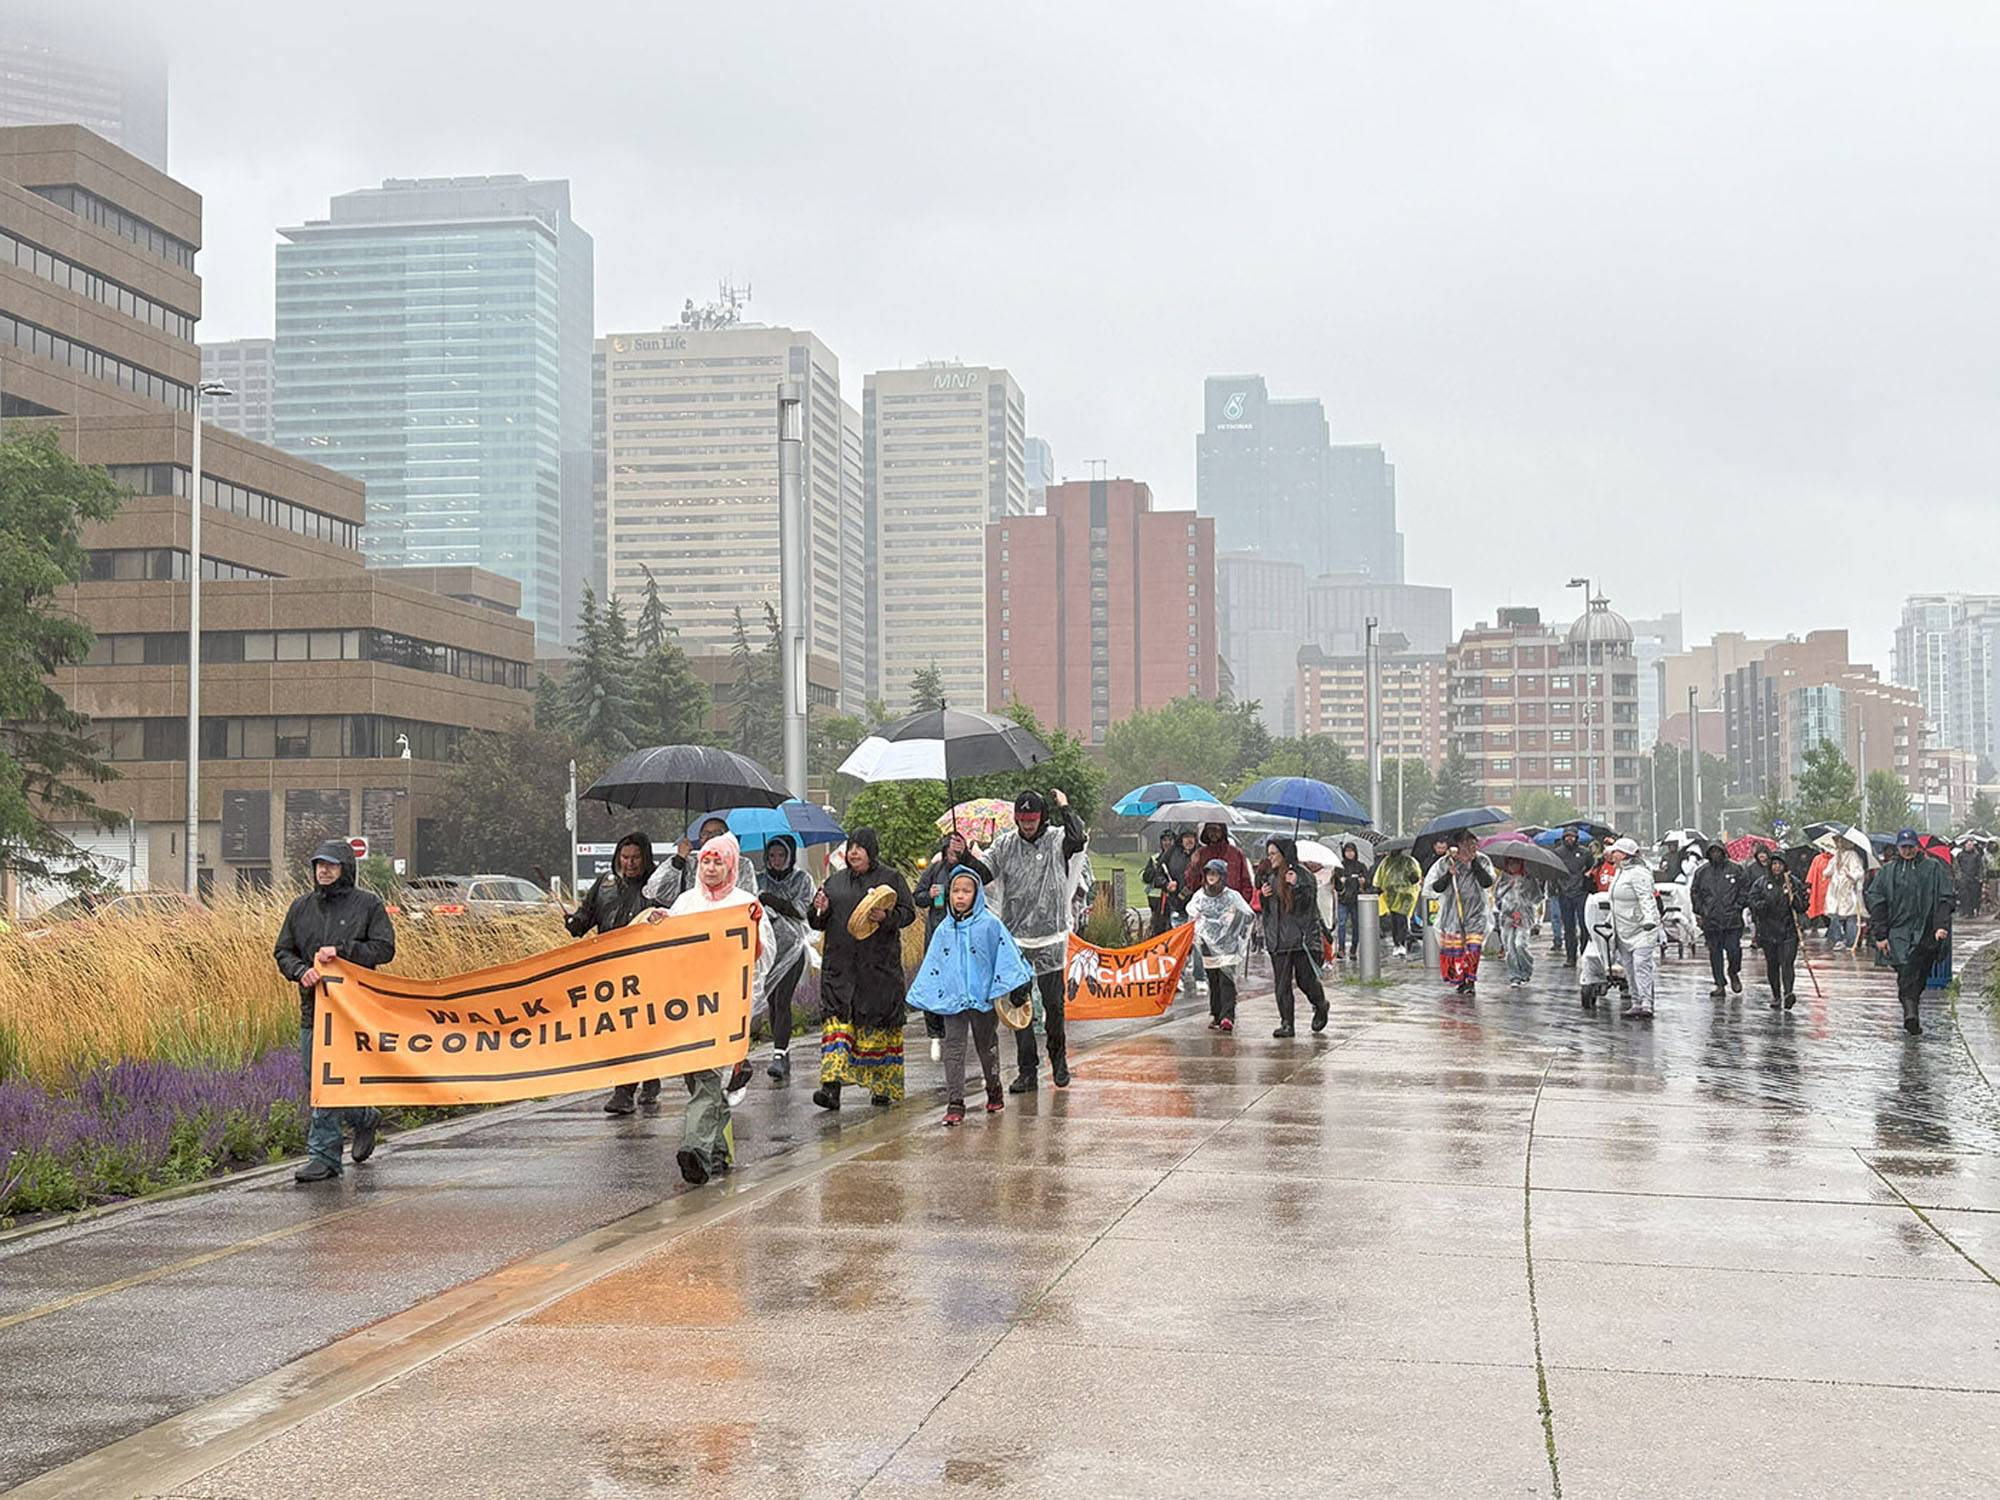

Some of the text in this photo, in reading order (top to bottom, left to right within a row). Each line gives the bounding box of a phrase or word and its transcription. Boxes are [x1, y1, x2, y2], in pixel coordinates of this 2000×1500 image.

[634, 336, 687, 351] Sun Life
[933, 372, 978, 389] MNP
[1096, 955, 1178, 984] CHILD
[427, 974, 641, 1026] WALK FOR
[354, 991, 721, 1053] RECONCILIATION
